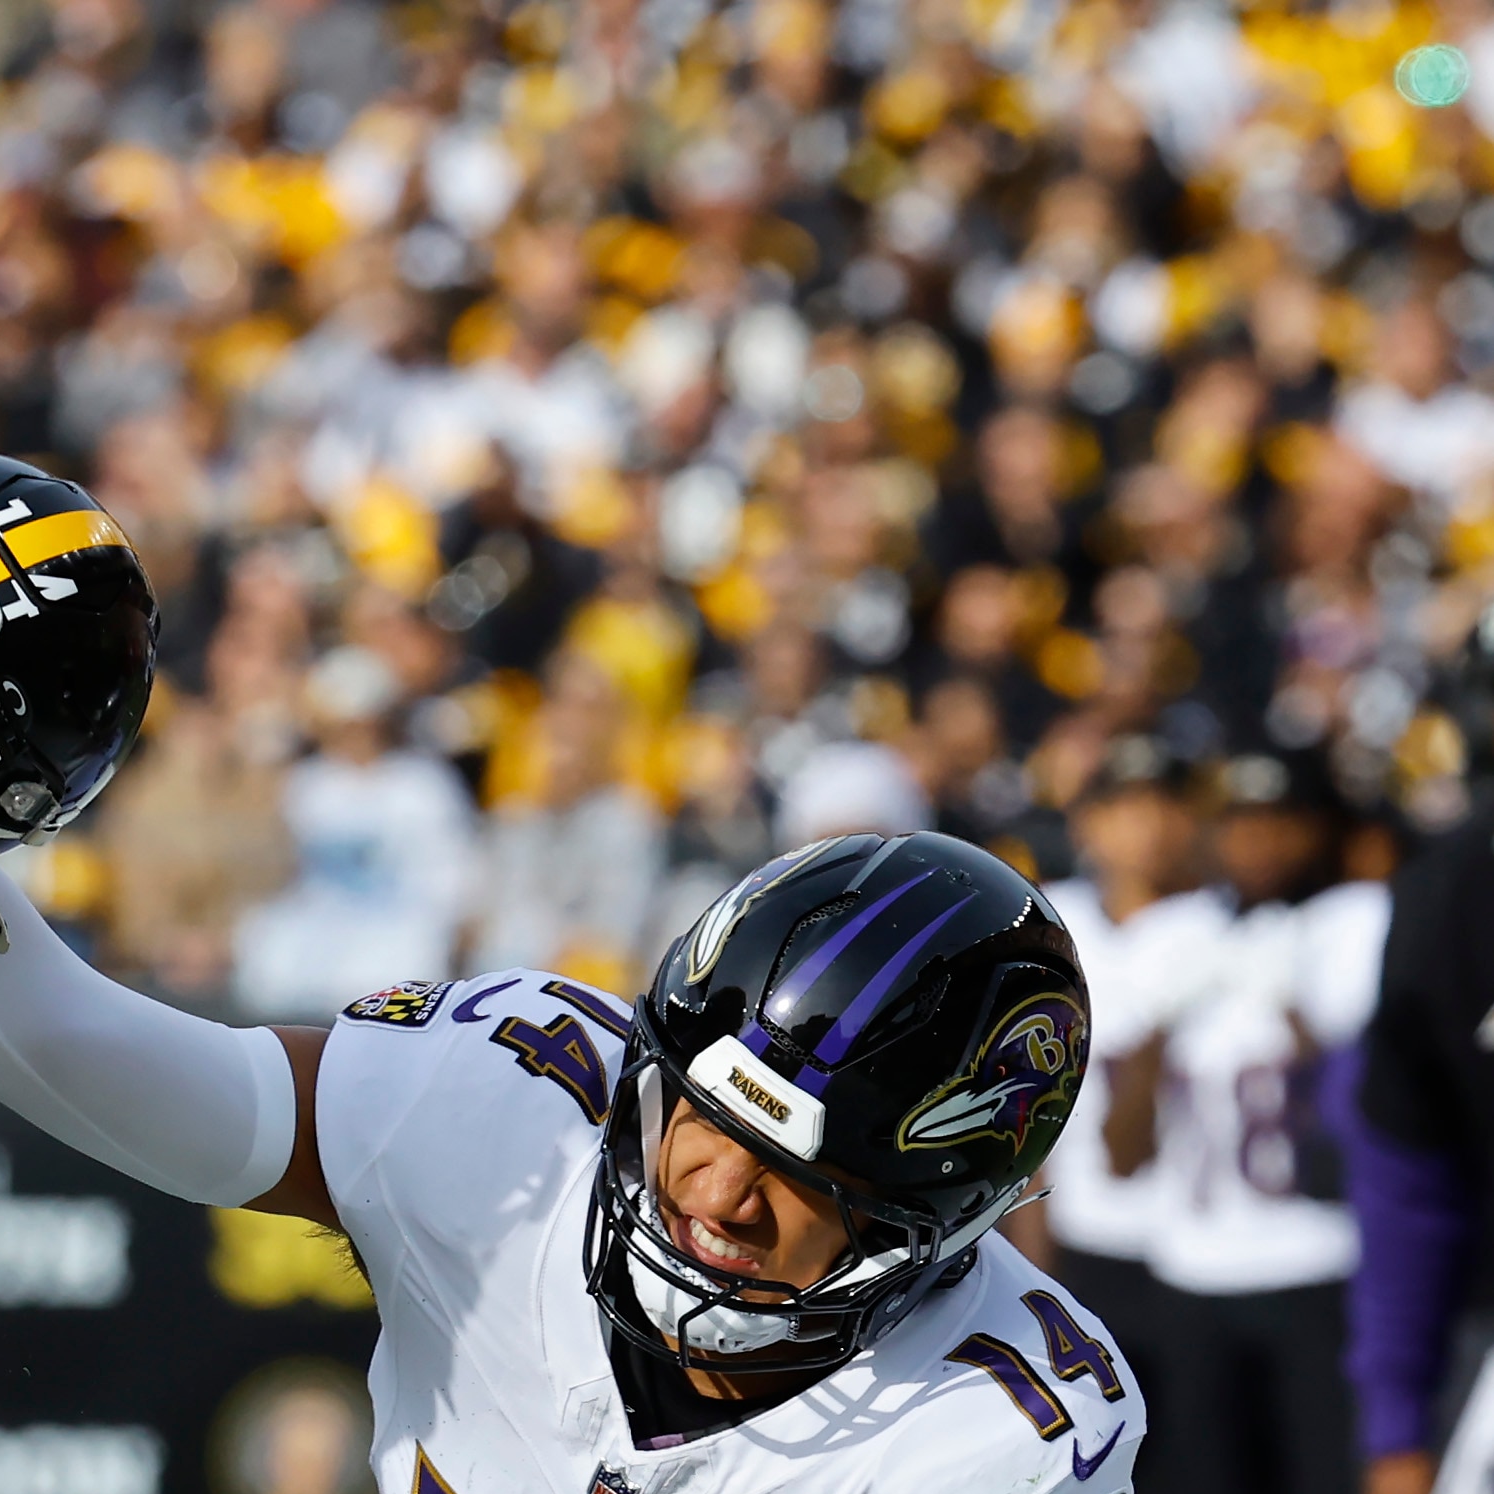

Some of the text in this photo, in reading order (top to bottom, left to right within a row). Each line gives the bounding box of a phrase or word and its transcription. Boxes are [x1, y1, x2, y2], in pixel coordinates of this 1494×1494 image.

[489, 981, 634, 1126] 14
[726, 1065, 793, 1124] RAVENS
[943, 1289, 1127, 1443] 14
